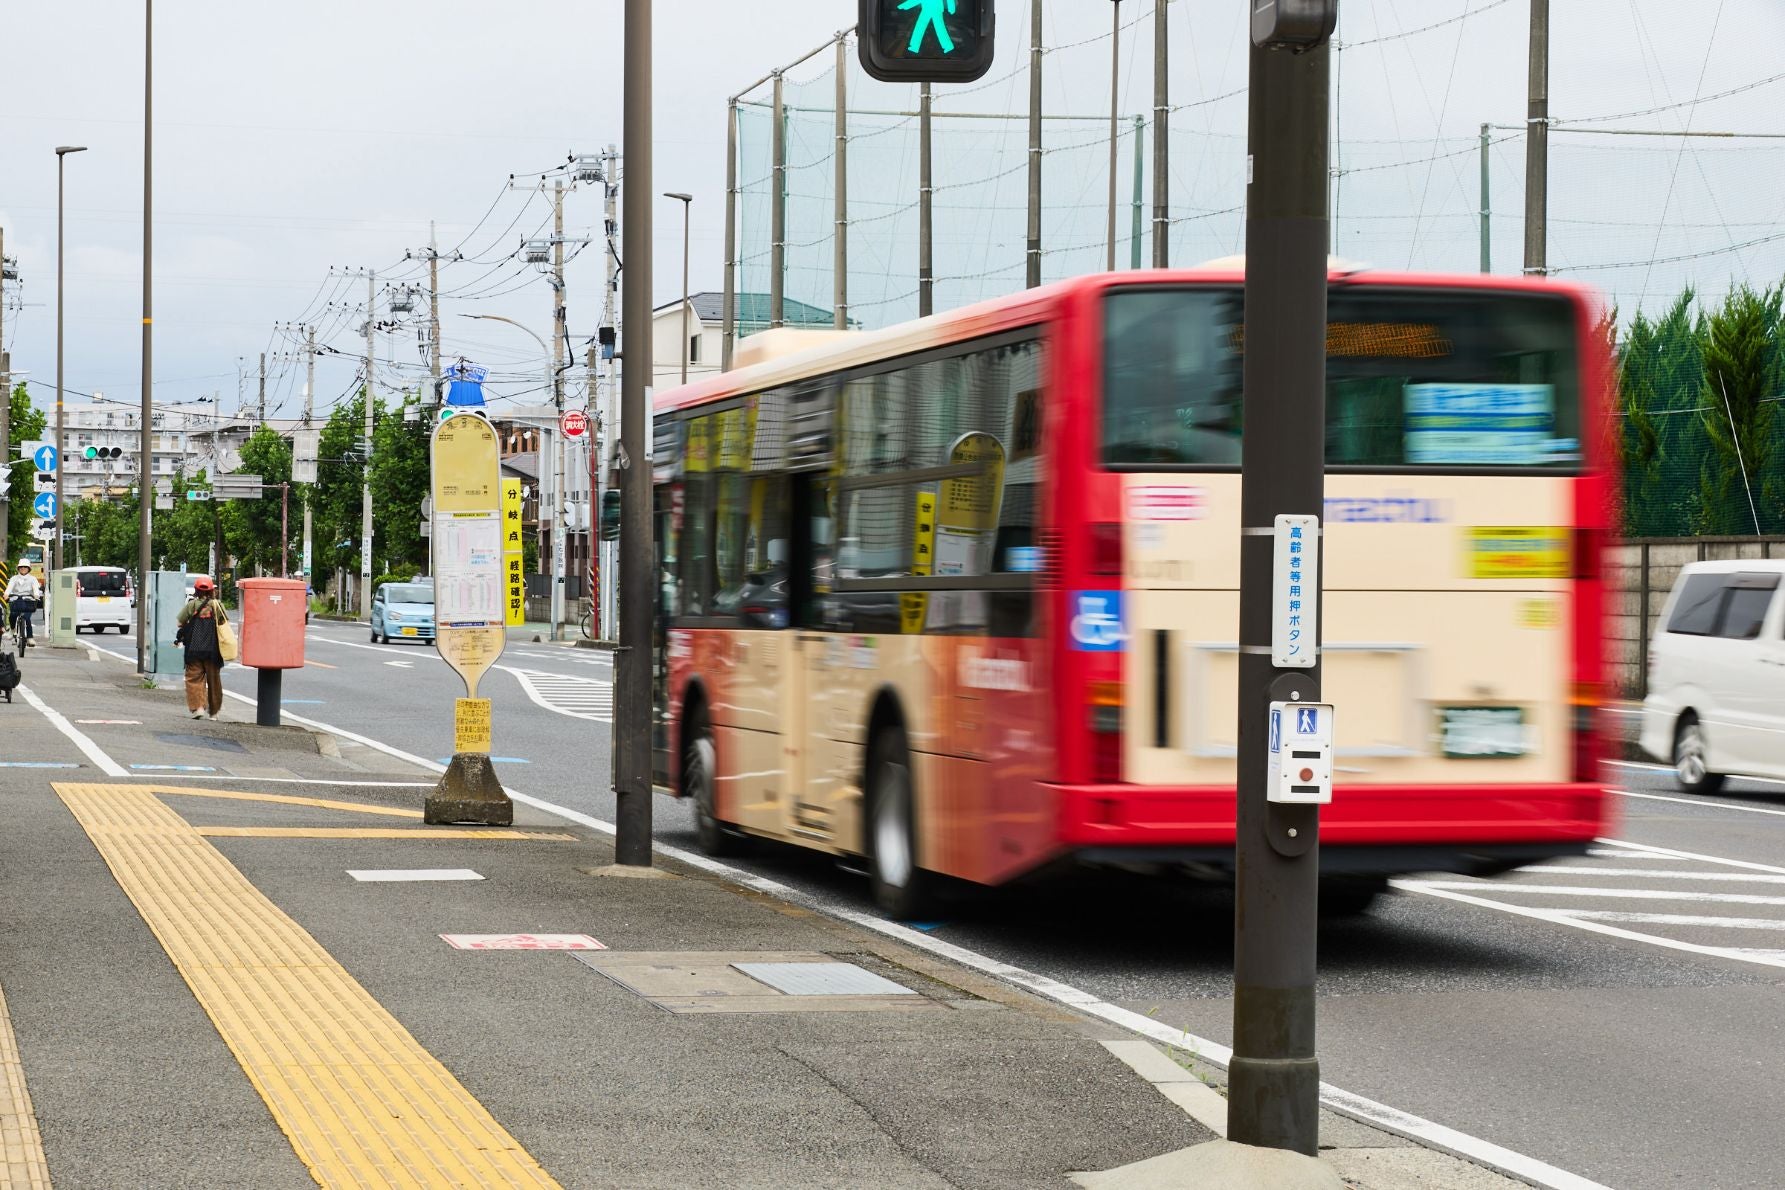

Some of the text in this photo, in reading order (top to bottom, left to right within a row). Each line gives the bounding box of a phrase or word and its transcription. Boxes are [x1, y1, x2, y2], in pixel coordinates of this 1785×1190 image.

[507, 488, 519, 542] 分岐点
[1288, 527, 1302, 656] 高齢者等用押ボタン
